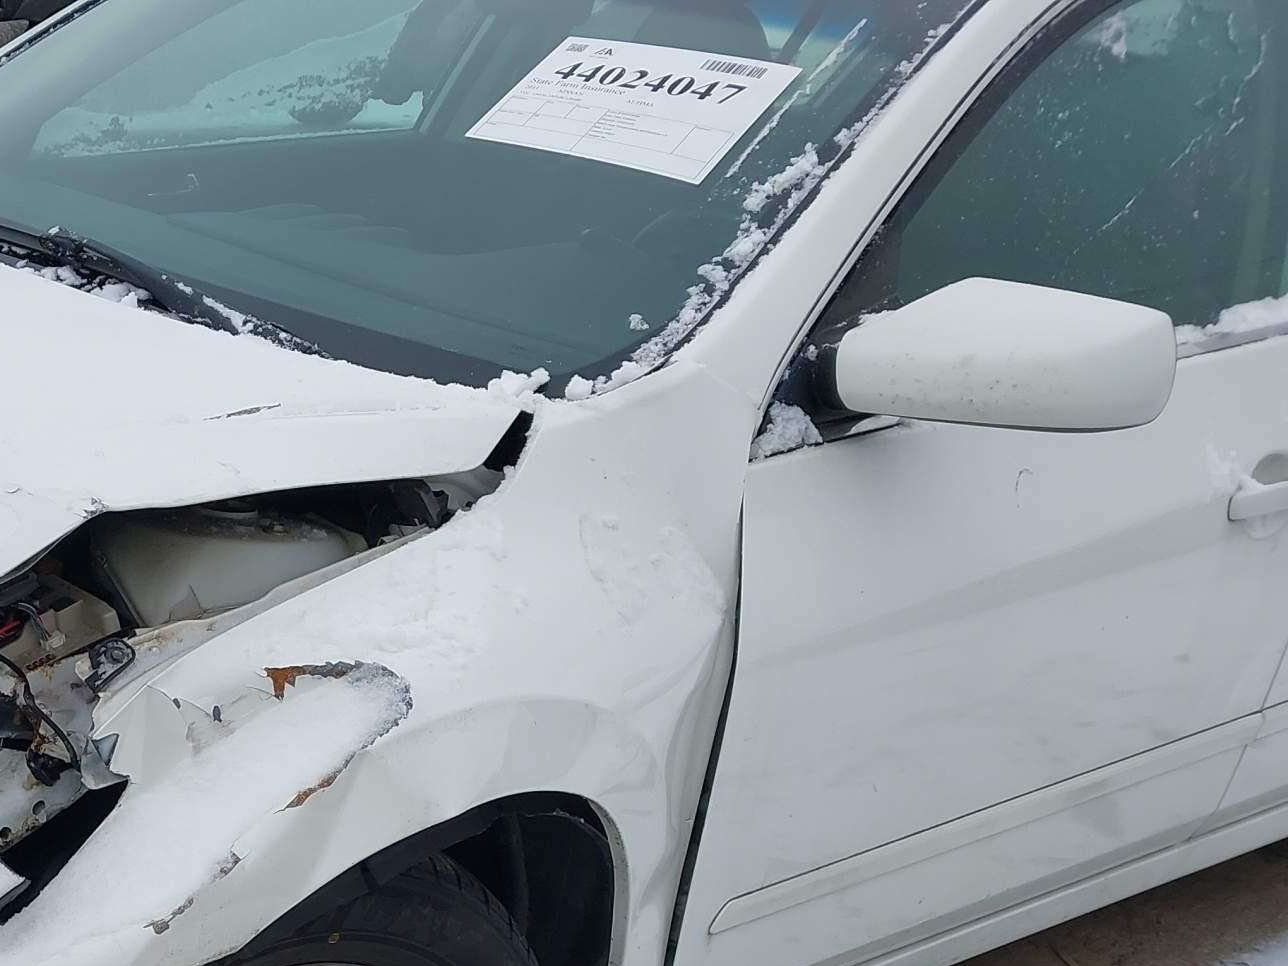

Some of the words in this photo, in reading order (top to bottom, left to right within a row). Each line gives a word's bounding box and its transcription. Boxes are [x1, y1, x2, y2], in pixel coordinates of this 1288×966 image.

[530, 76, 554, 86] State
[554, 80, 580, 90] Farm
[580, 82, 626, 96] Insurance
[555, 62, 747, 103] 44024047
